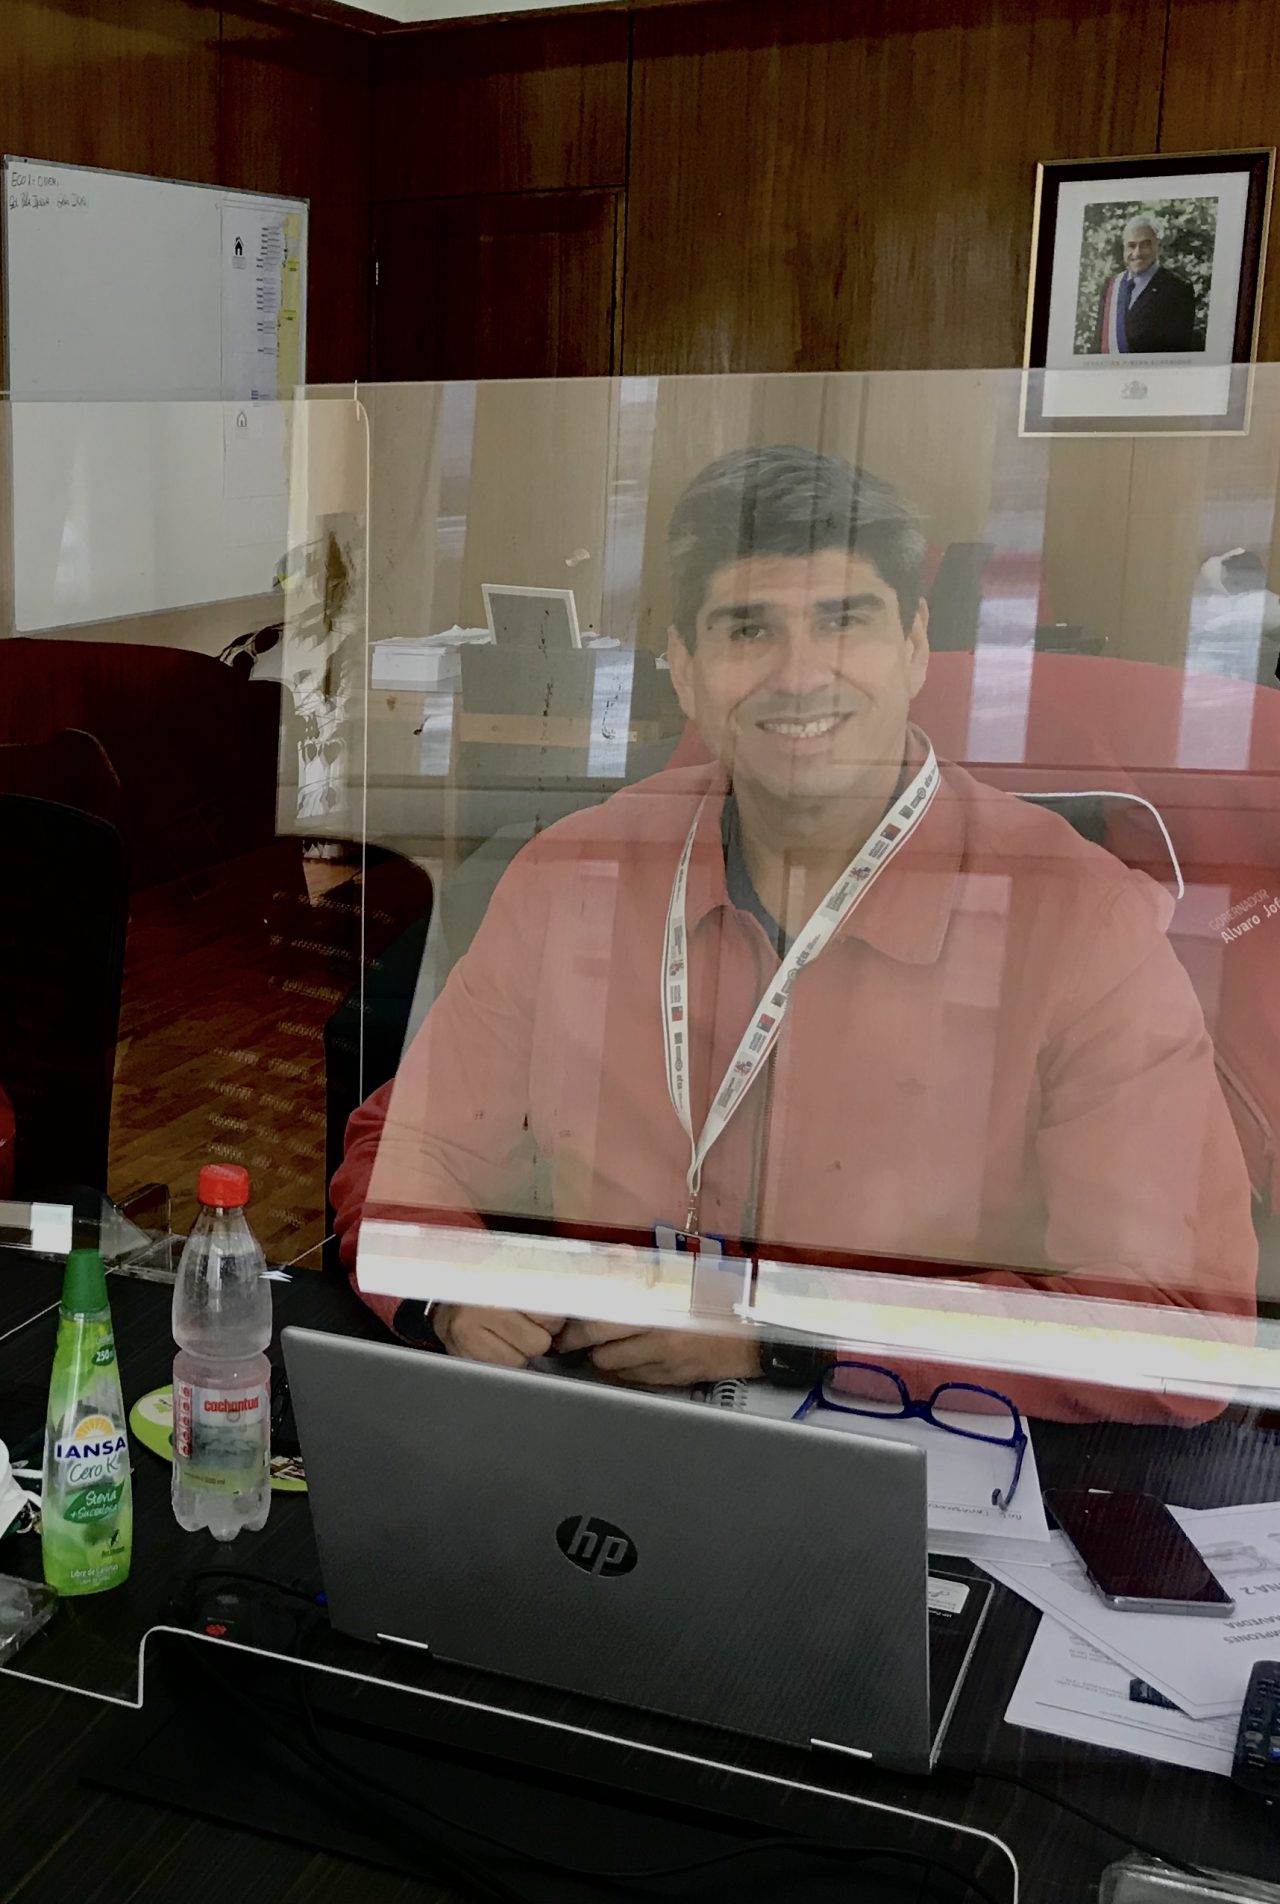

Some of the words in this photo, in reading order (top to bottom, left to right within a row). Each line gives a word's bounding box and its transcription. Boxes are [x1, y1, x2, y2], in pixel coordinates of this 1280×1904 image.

[1209, 889, 1270, 931] GOBERNADOR
[1220, 913, 1261, 944] Alvaro
[56, 1436, 126, 1459] IANSA
[70, 1463, 103, 1483] Cero
[106, 1454, 119, 1474] K
[86, 1490, 117, 1506] Stevia
[567, 1514, 629, 1576] hp
[1239, 1586, 1256, 1596] 2
